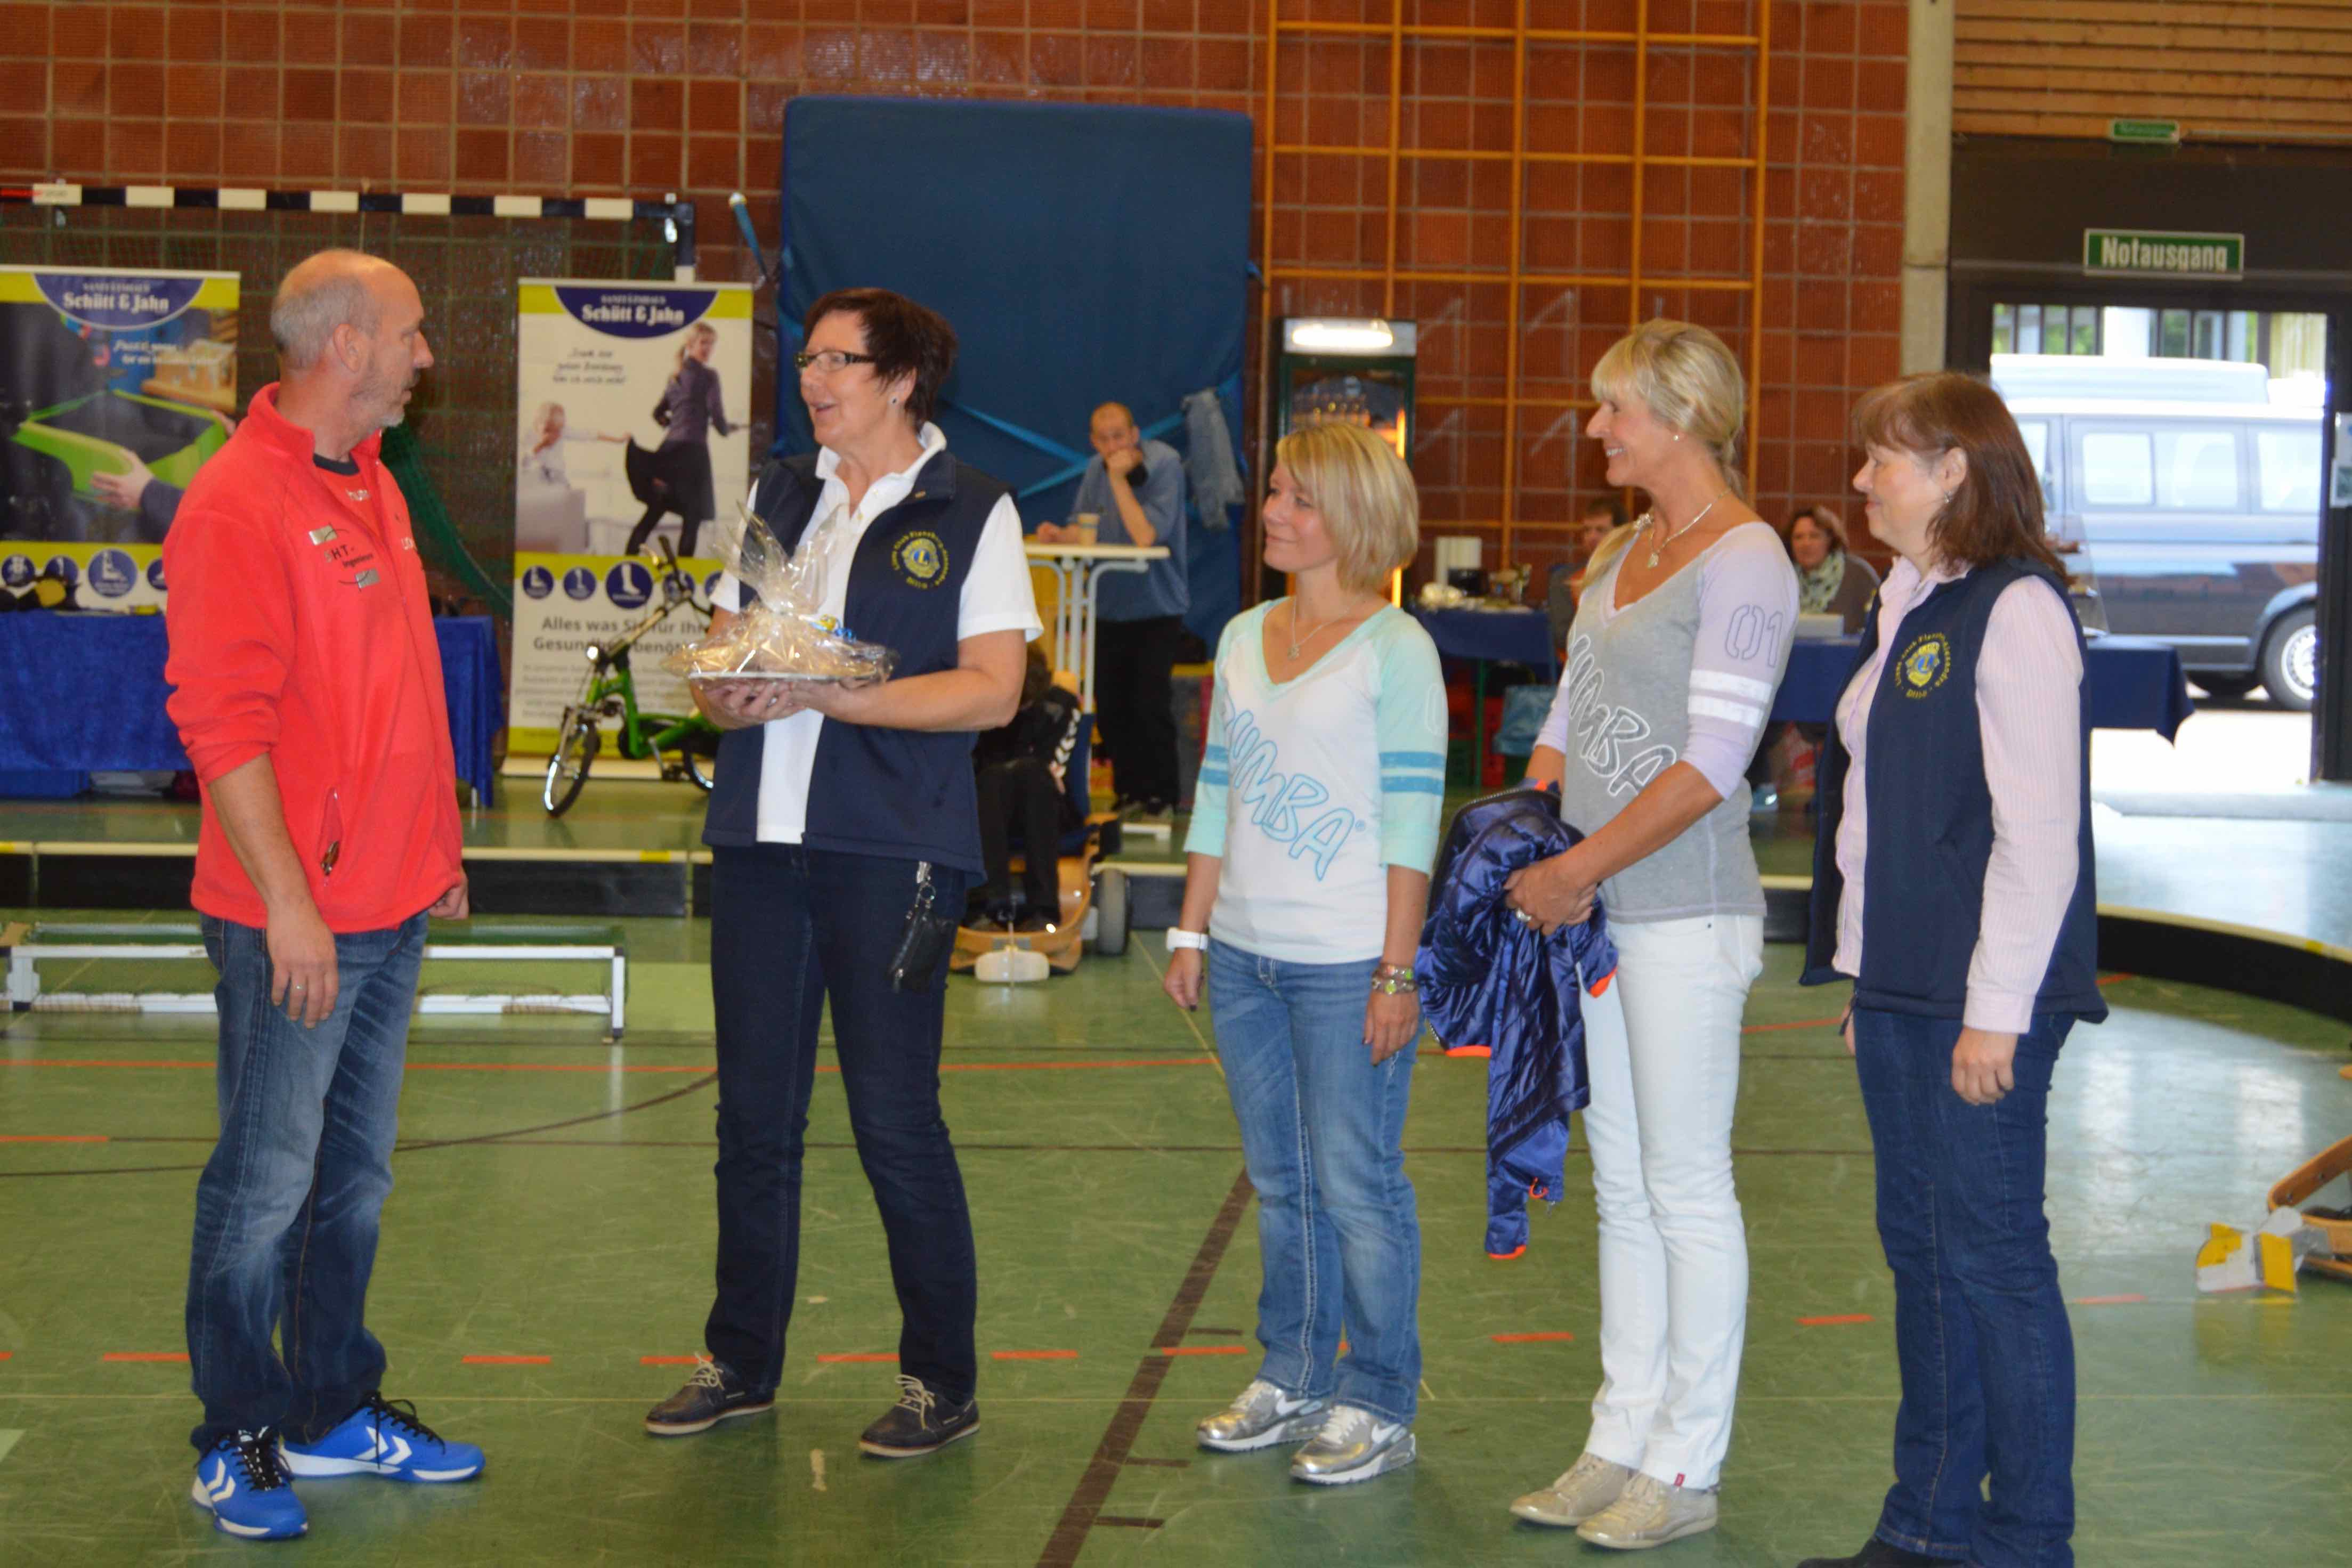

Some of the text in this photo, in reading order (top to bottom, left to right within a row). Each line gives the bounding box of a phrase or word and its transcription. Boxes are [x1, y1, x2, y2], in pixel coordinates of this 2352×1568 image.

[2102, 237, 2227, 271] Notausgang
[63, 291, 169, 314] Schütt & Jahn
[582, 304, 685, 327] Schütt & Jahn
[541, 616, 581, 631] Alles
[587, 620, 618, 631] was
[1725, 604, 1783, 668] 01
